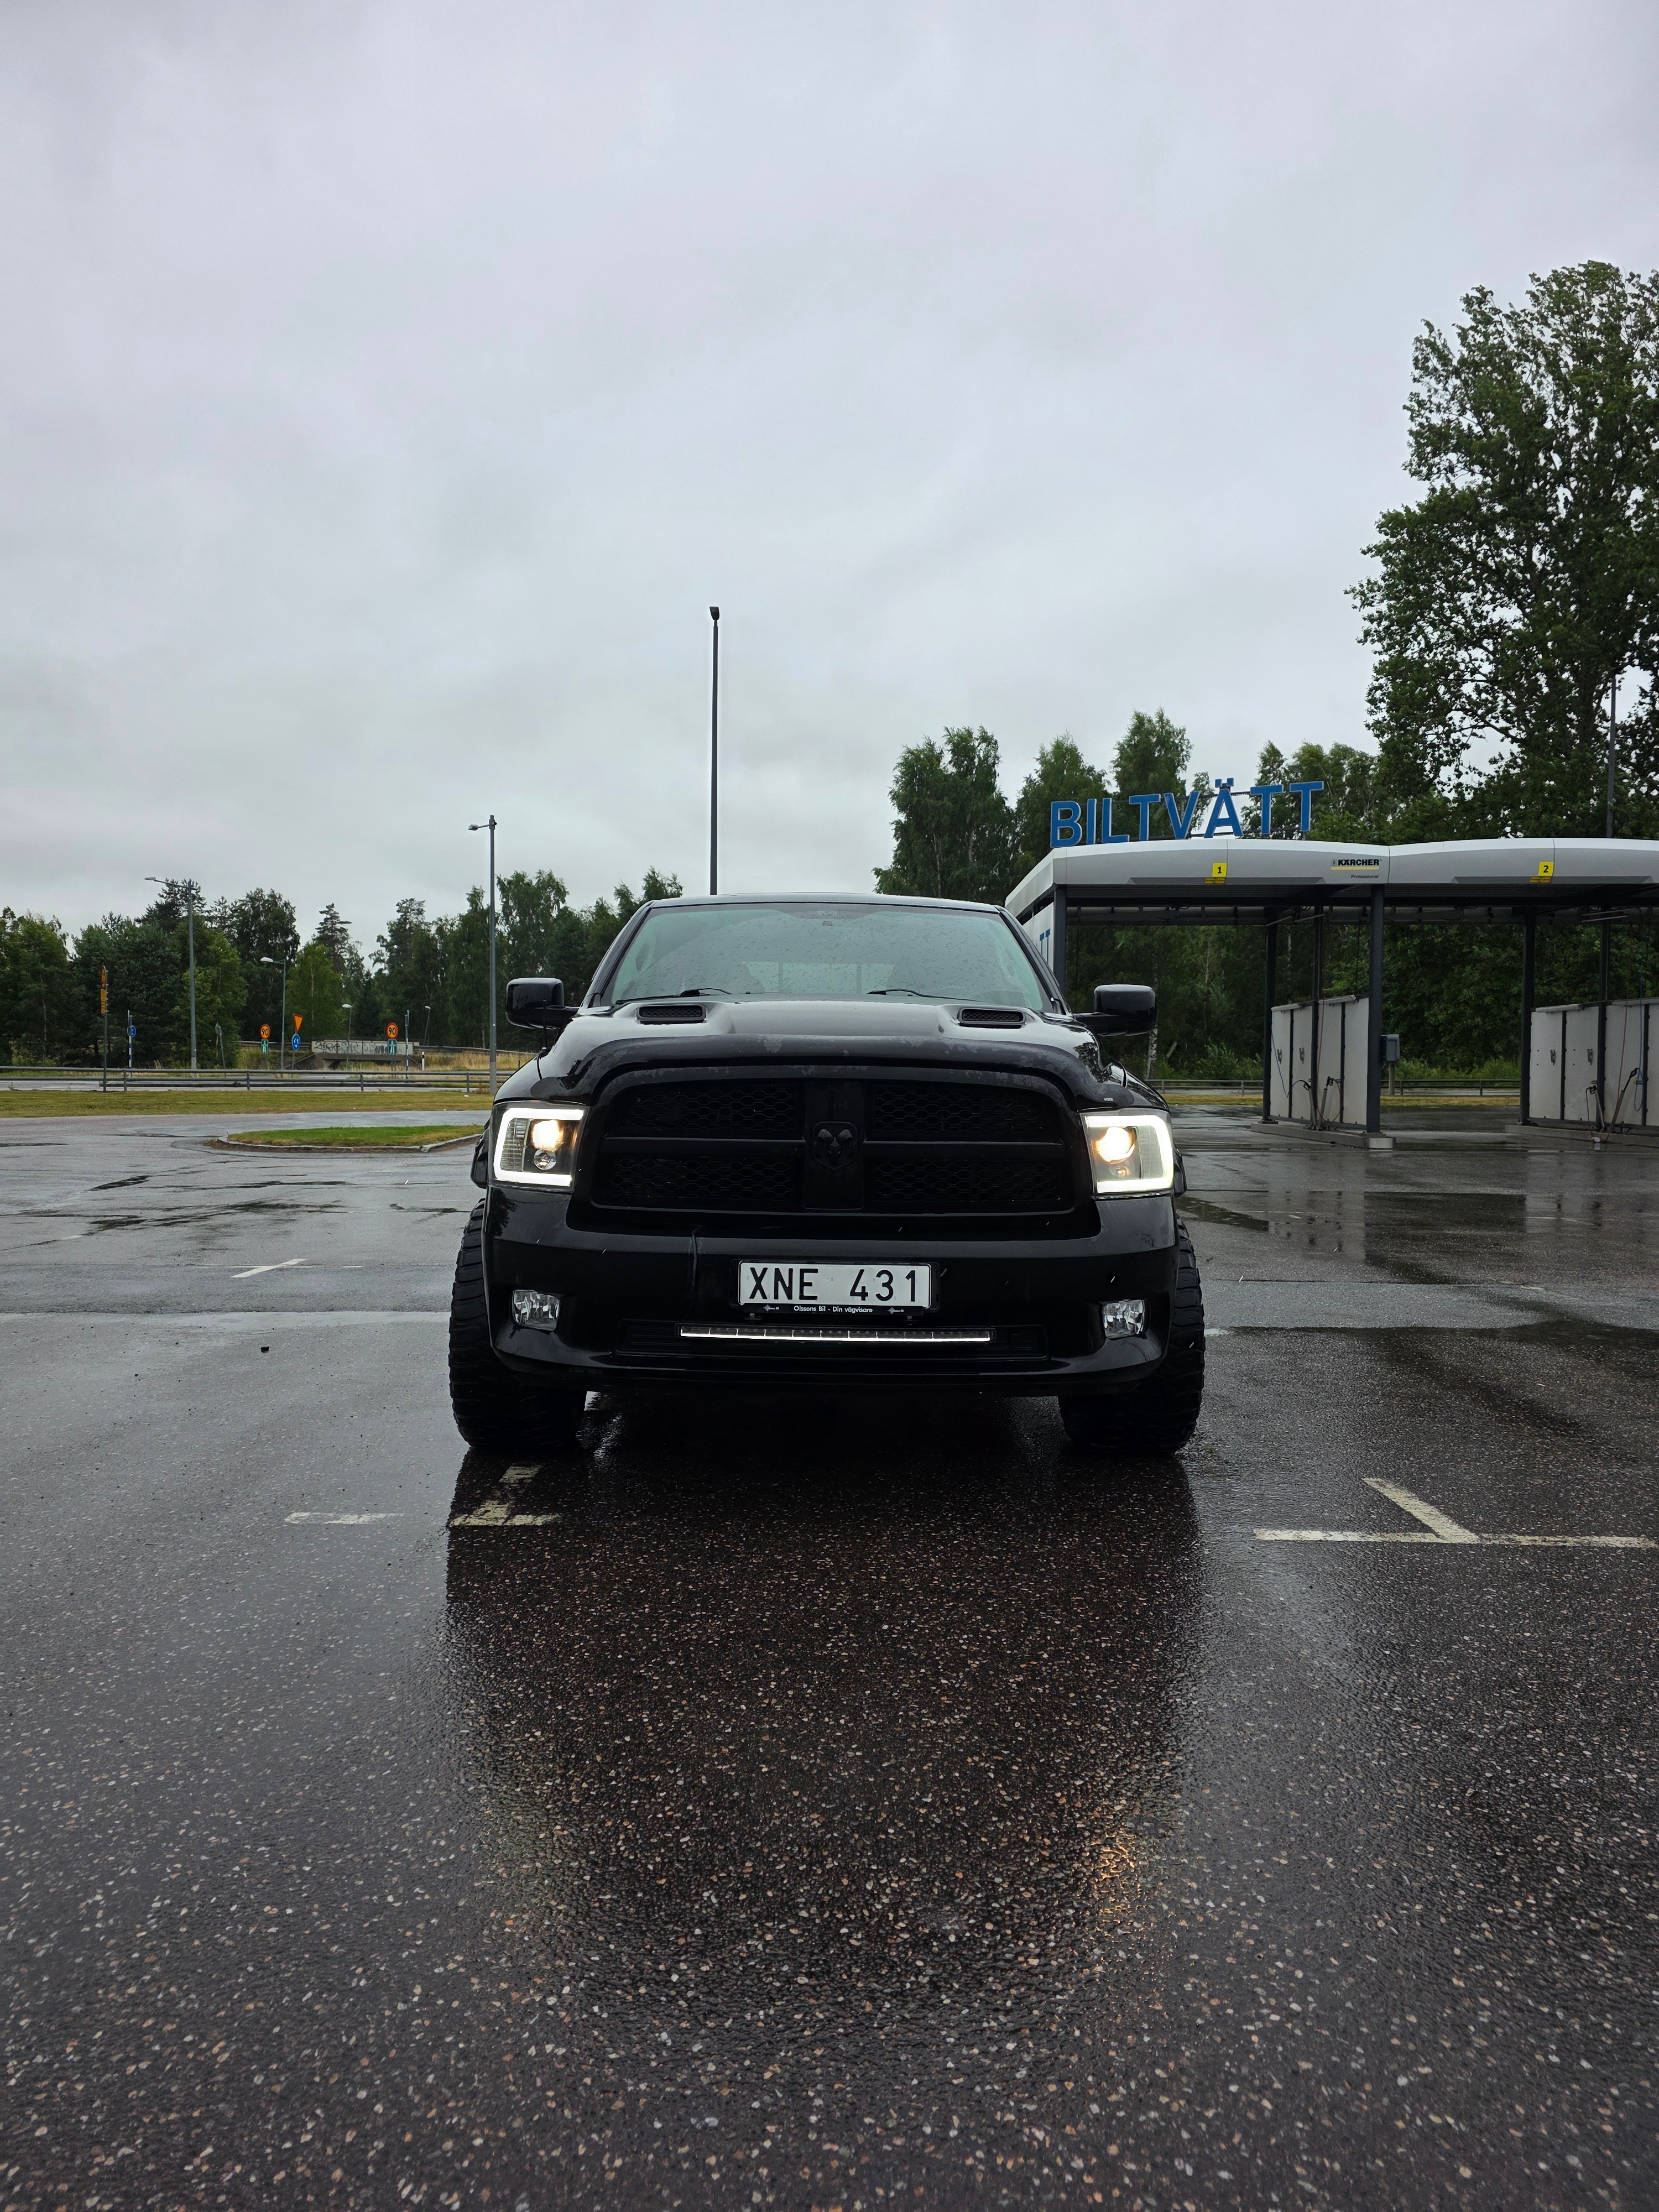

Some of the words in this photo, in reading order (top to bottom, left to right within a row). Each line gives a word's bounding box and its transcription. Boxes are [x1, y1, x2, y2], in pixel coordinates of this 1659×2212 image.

[1050, 778, 1324, 848] BILTVÄTT
[1543, 865, 1549, 873] 2
[388, 1027, 397, 1035] 90
[749, 1267, 818, 1300] XNE
[849, 1269, 916, 1302] 431
